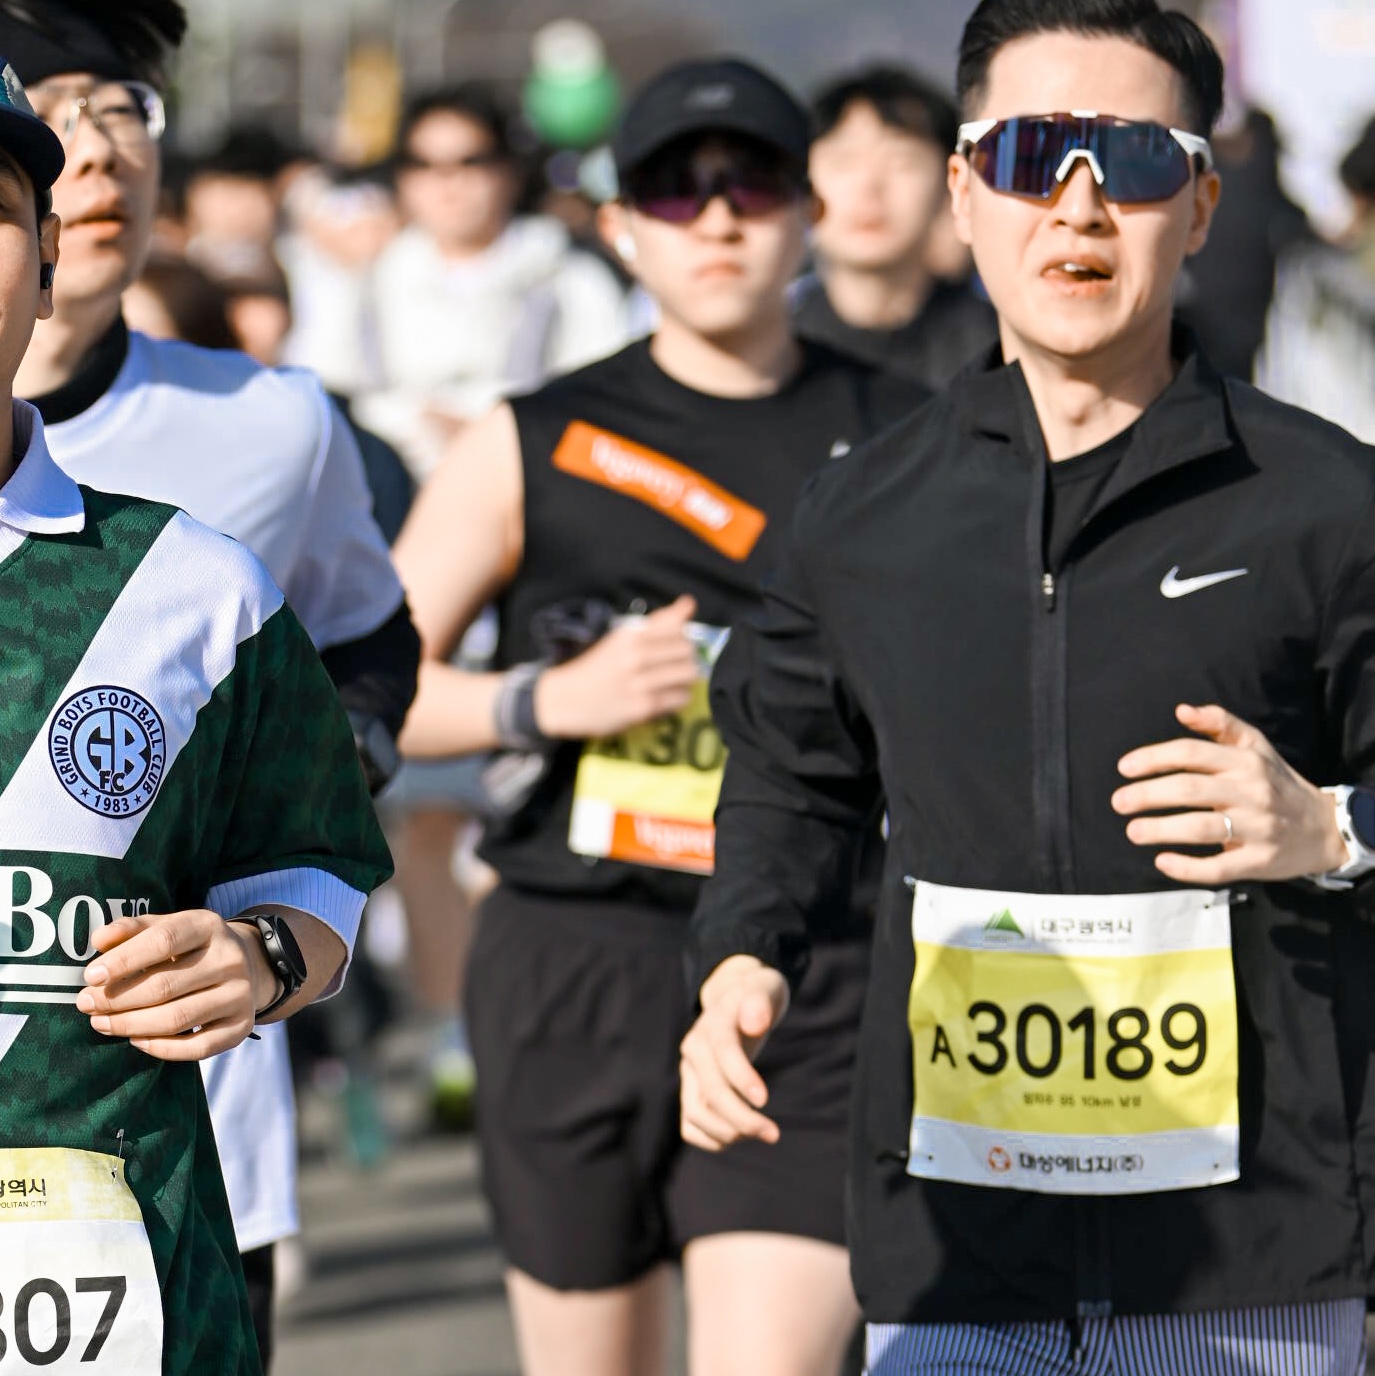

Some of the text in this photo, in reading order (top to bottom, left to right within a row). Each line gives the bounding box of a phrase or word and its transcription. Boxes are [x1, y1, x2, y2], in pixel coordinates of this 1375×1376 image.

[54, 692, 163, 795] GRIND BOYS FOOTBALL CLUB
[94, 794, 130, 812] 1983
[99, 770, 125, 792] FC
[931, 1001, 1207, 1080] A30189
